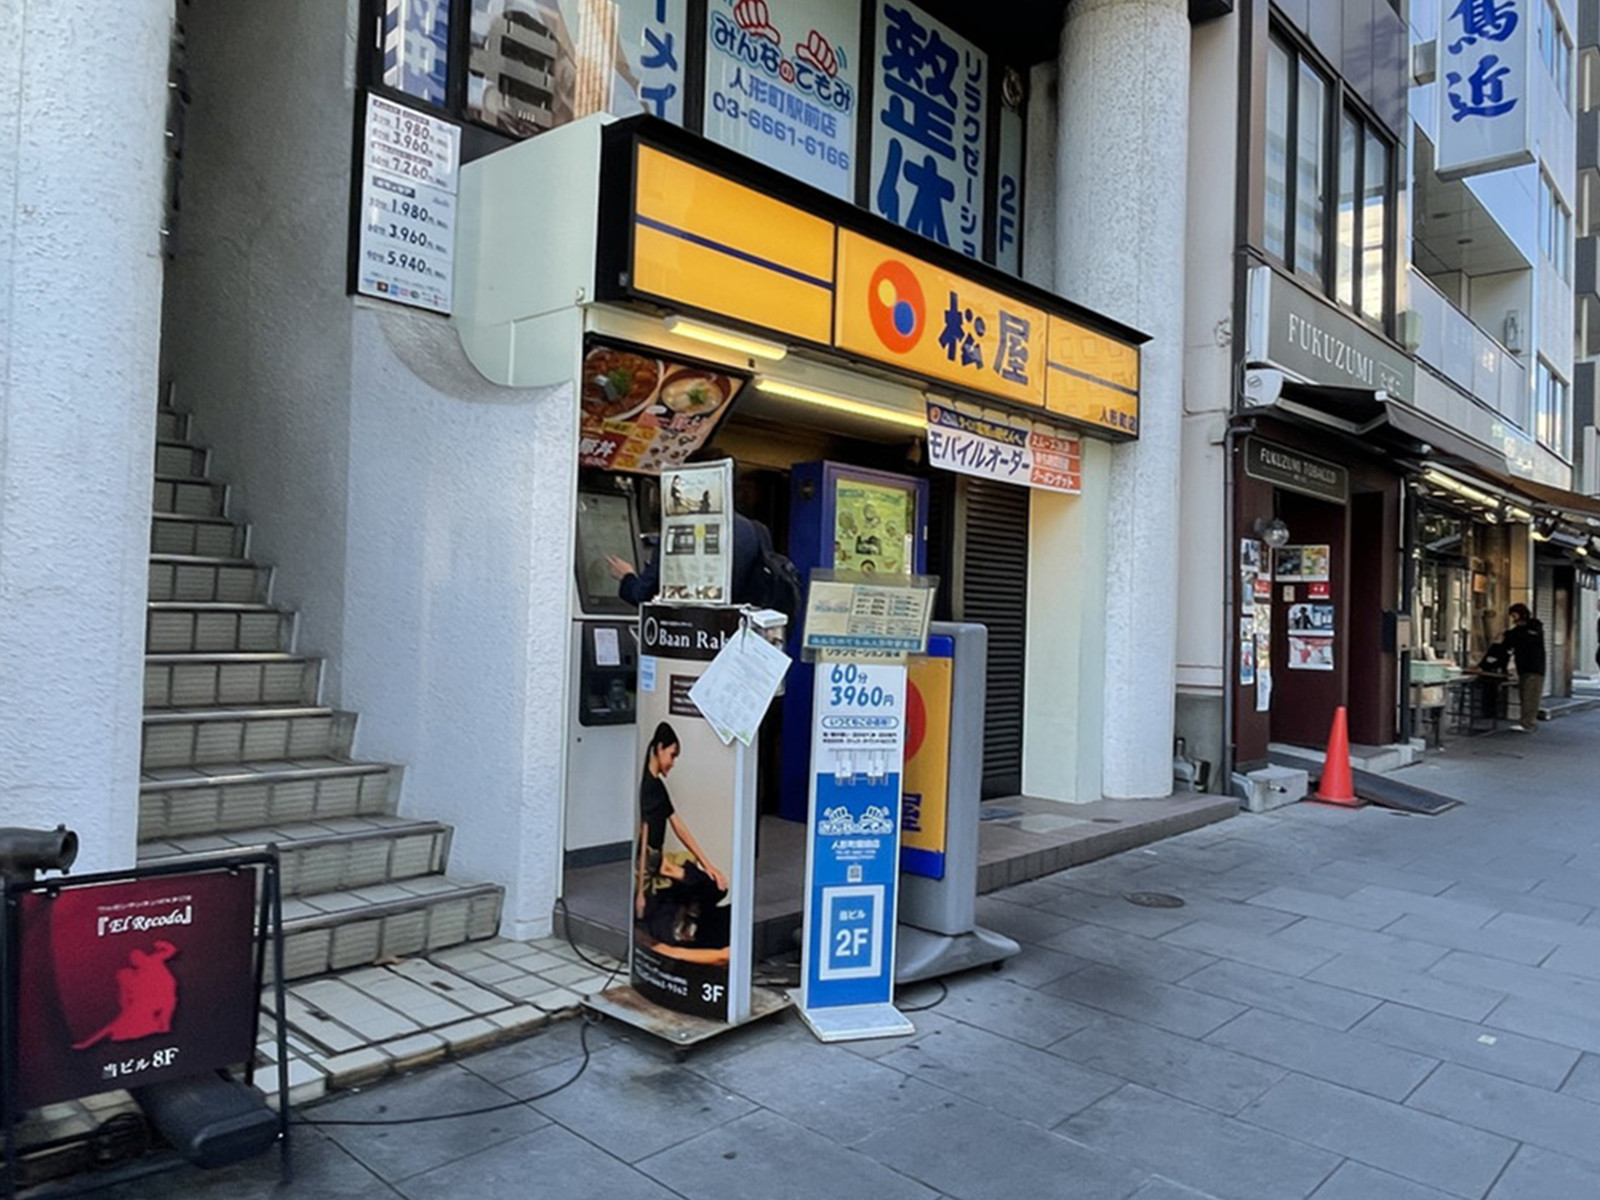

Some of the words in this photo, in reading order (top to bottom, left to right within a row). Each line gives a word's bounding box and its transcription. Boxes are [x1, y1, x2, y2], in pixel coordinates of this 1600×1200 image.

[715, 17, 852, 111] みんなのてもみ
[713, 91, 850, 171] 03-6661-6166
[729, 66, 837, 139] 人形町駅前店
[1000, 174, 1017, 253] 2F
[938, 290, 1030, 386] 松屋
[1288, 313, 1374, 385] FUKUZUMI
[929, 431, 1030, 476] モバイルオーダー
[659, 628, 690, 648] Baan
[830, 685, 894, 707] 3960円
[831, 663, 868, 684] 60分
[835, 928, 869, 956] 2F
[702, 983, 724, 1002] 3F
